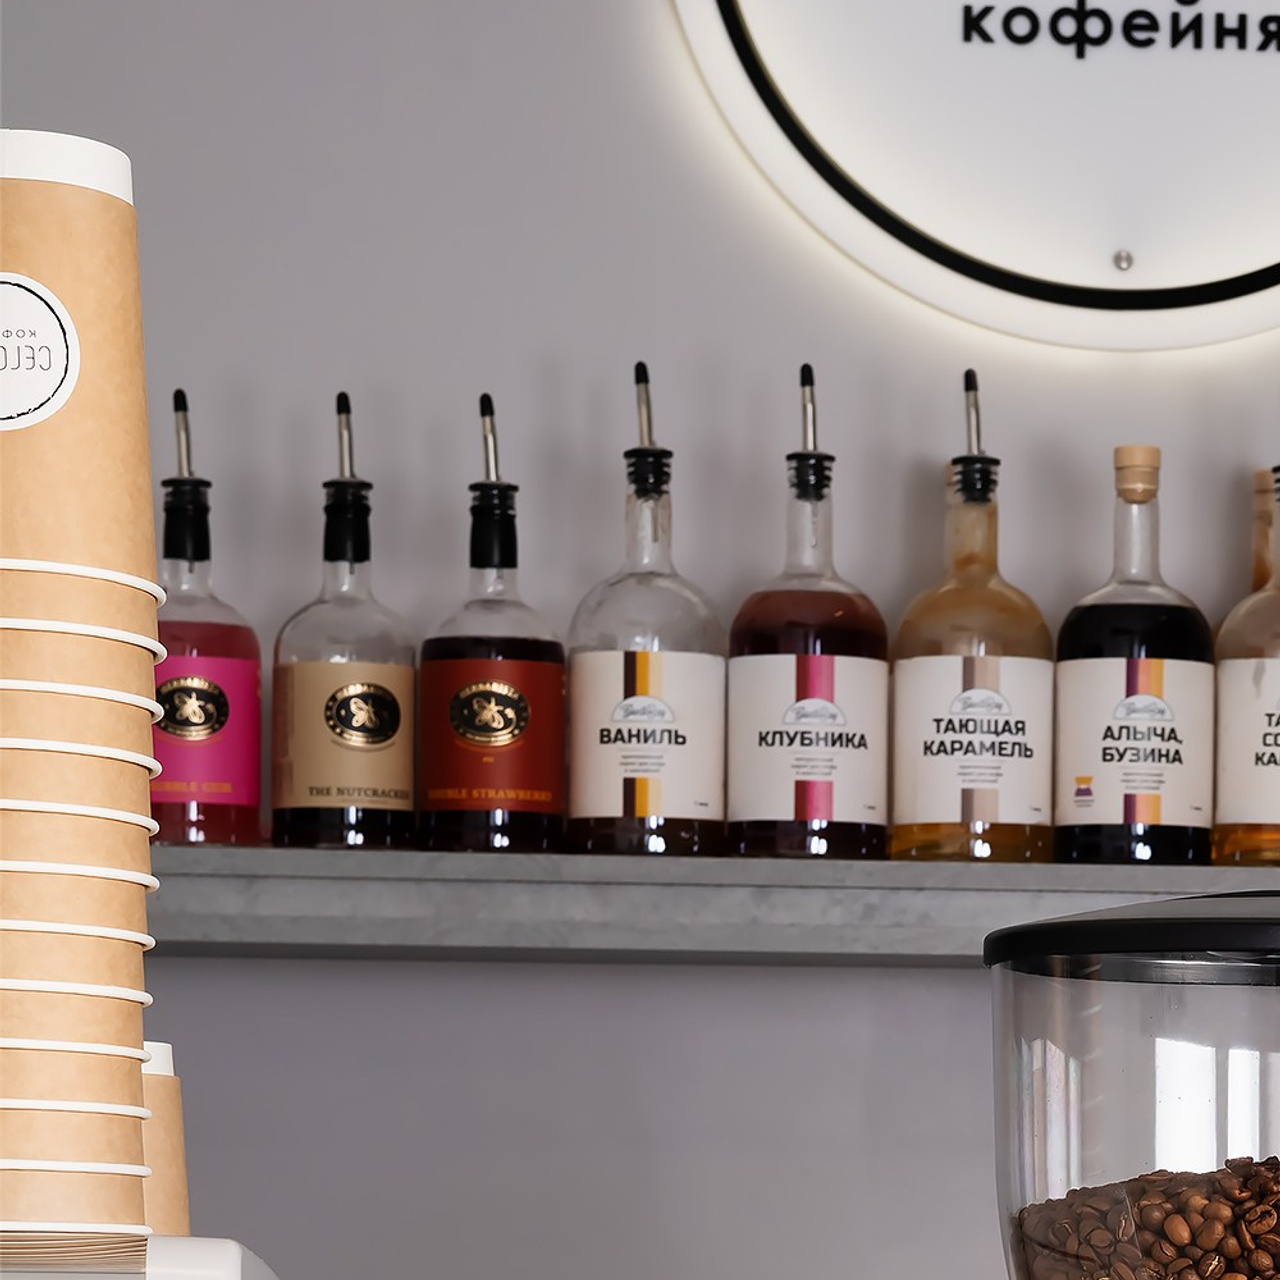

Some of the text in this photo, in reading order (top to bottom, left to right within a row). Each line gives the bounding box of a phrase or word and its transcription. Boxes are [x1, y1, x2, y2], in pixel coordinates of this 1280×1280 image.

[599, 728, 686, 745] ВАНИЛЬ
[933, 718, 1025, 737] ТАЮЩАЯ
[1102, 726, 1182, 744] АЛЫЧА,
[759, 731, 867, 749] КЛУБНИКА
[924, 740, 1033, 758] КАРАМЕЛЬ
[1102, 747, 1183, 764] БУЗИНА
[308, 786, 332, 796] THE
